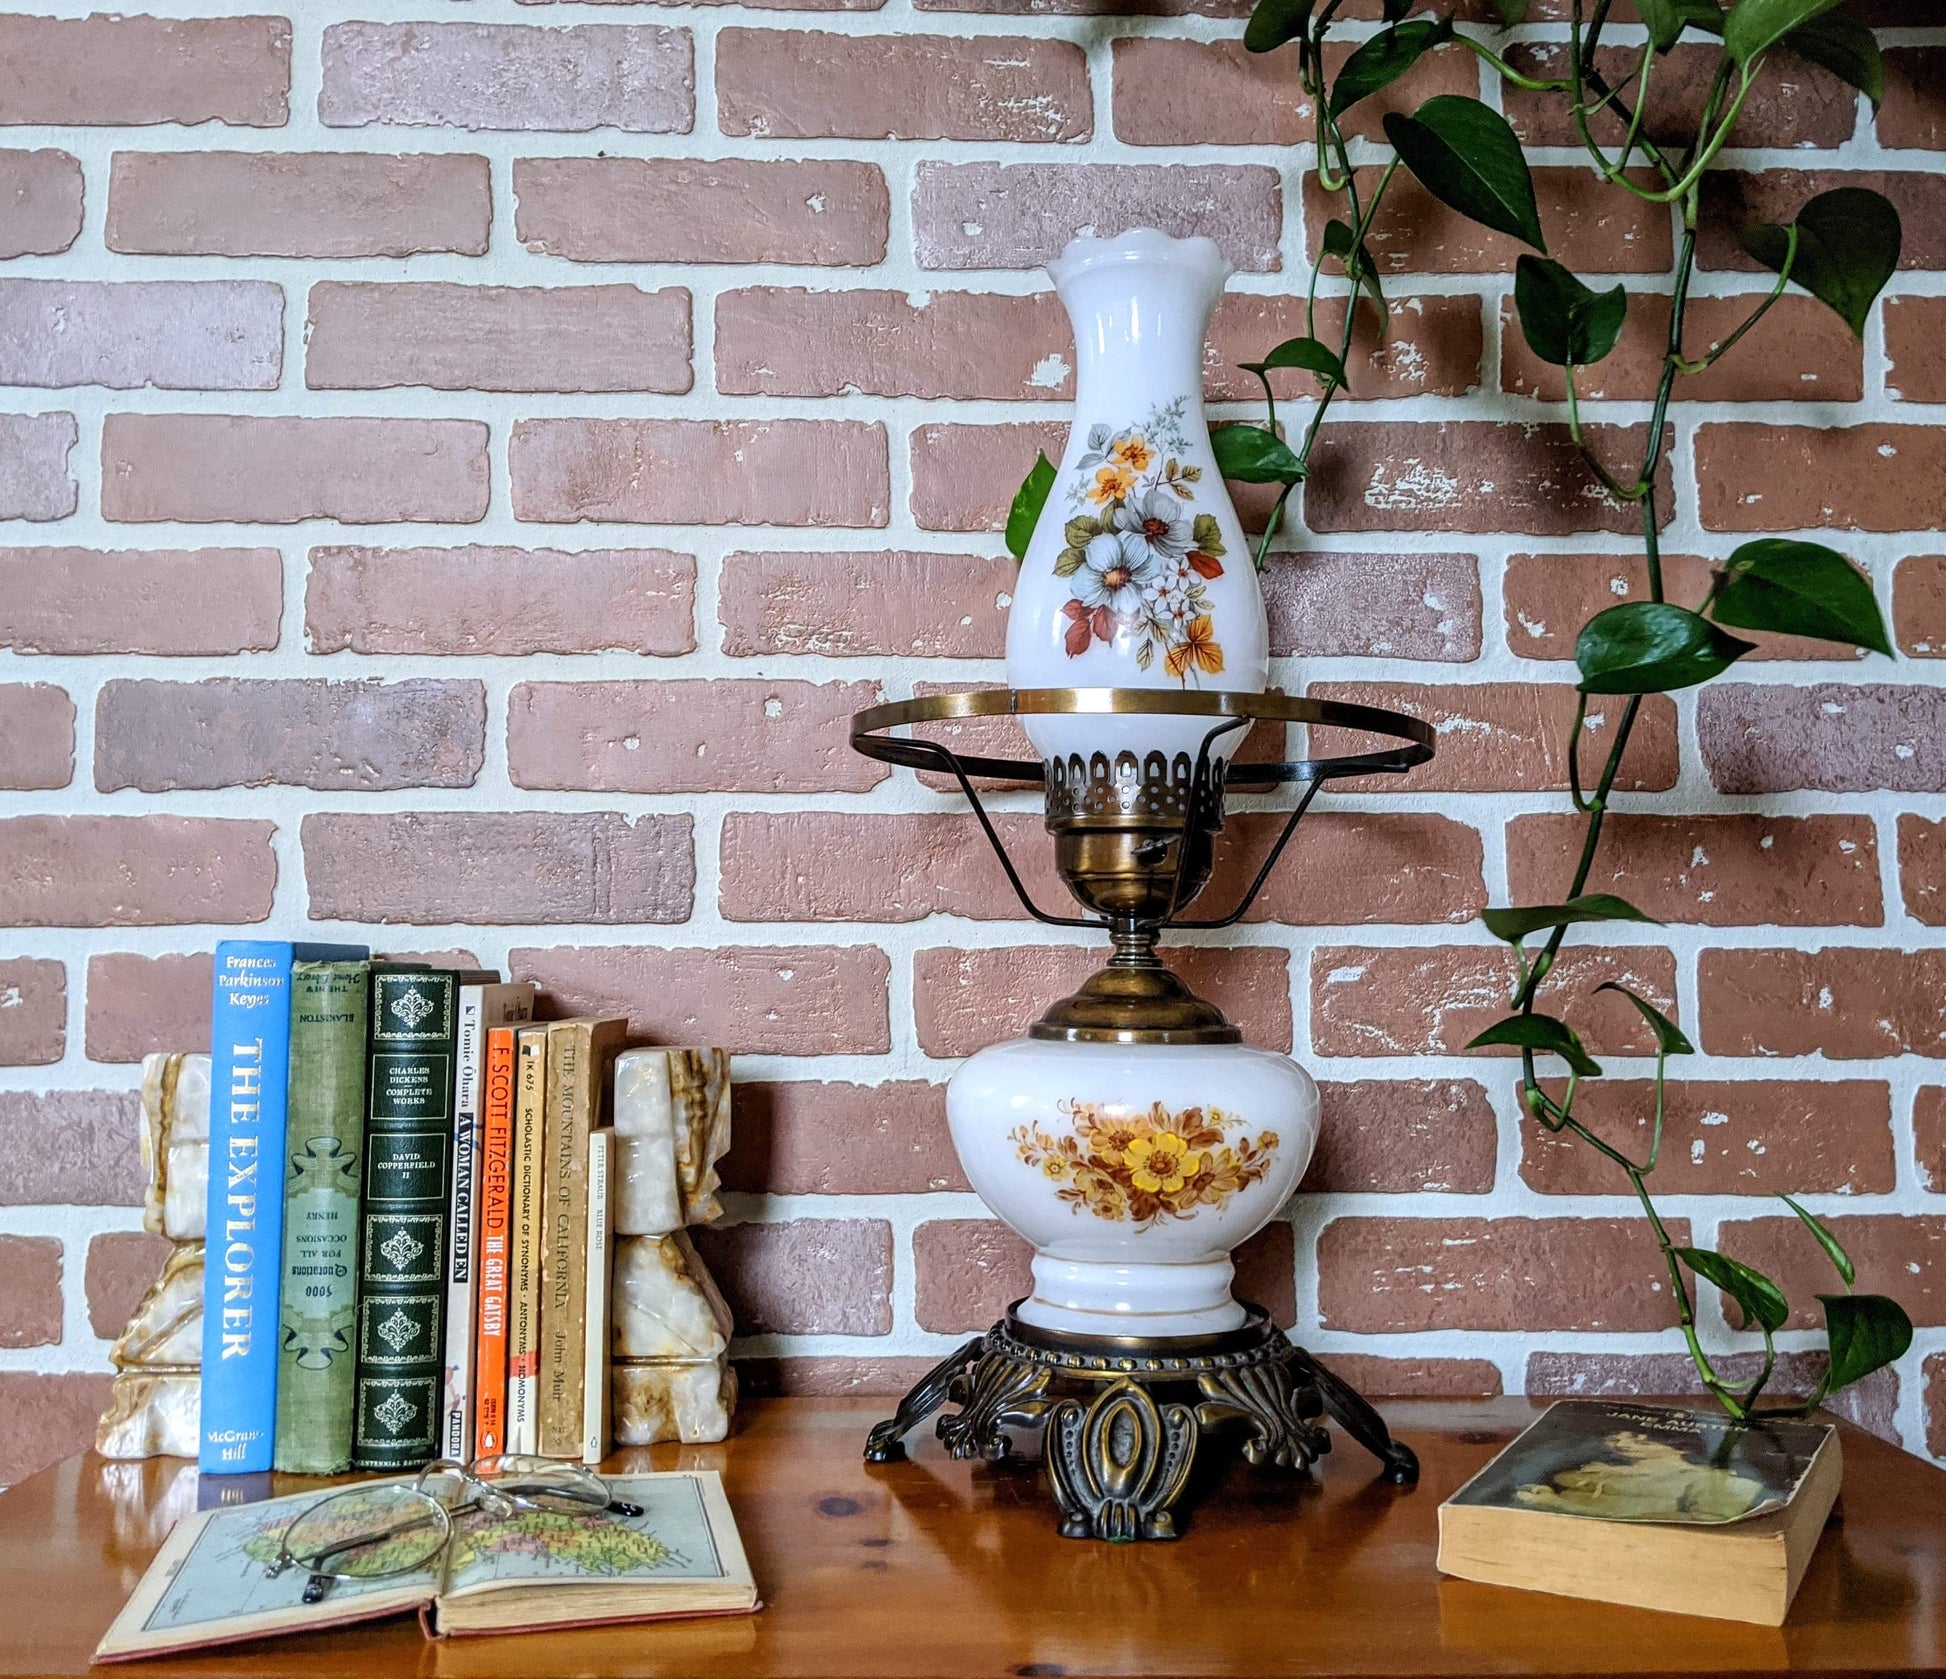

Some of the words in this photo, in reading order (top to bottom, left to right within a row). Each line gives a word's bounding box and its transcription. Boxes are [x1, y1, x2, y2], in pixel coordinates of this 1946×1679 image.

[226, 956, 276, 968] Frances
[219, 970, 284, 987] Parkinson
[333, 973, 360, 984] Home
[305, 985, 325, 993] NEW
[329, 985, 348, 993] THE
[229, 992, 269, 1008] Keyes
[300, 1013, 354, 1023] BLAKISTON
[463, 1019, 475, 1062] Tomie
[492, 1047, 509, 1059] F.
[563, 1044, 576, 1078] THE
[389, 1067, 430, 1075] CHARLES
[389, 1076, 429, 1084] DICKENS
[230, 1037, 263, 1124] THE
[526, 1073, 534, 1091] 675
[386, 1088, 433, 1096] COMPLETE
[490, 1064, 509, 1119] SCOTT
[393, 1097, 426, 1105] WORKS
[459, 1115, 471, 1127] A
[523, 1108, 533, 1162] SCHOLASTIC
[559, 1085, 574, 1179] MOUNTAINS
[377, 1161, 435, 1170] COPPERFIELD
[392, 1153, 420, 1161] DAVID
[458, 1130, 473, 1189] WOMAN
[402, 1171, 410, 1179] II
[487, 1127, 507, 1229] FITZGERALD
[521, 1165, 532, 1221] DICTIONARY
[596, 1170, 604, 1200] STRAUB
[558, 1186, 571, 1207] OF
[306, 1211, 338, 1220] HENRY
[455, 1192, 469, 1254] CALLED
[296, 1234, 347, 1243] OCCASIONS
[521, 1223, 530, 1236] OF
[222, 1135, 259, 1361] EXPLORER
[486, 1235, 504, 1254] THE
[595, 1230, 603, 1250] ROSE
[300, 1250, 318, 1258] ALL
[322, 1250, 341, 1258] FOR
[555, 1214, 570, 1309] CALIFORNIA
[292, 1264, 348, 1277] Quotations
[454, 1258, 467, 1279] EN
[485, 1258, 503, 1291] GREAT
[520, 1239, 529, 1292] SYNONYMS
[305, 1285, 333, 1298] 5000
[484, 1296, 502, 1336] GATSBY
[518, 1301, 528, 1355] ANTONYMS
[554, 1332, 566, 1363] John
[516, 1365, 526, 1423] HOMONYMS
[553, 1370, 565, 1402] Muir
[1606, 1411, 1659, 1423] JANE
[450, 1411, 461, 1457] PANDORA
[1640, 1421, 1701, 1433] EMMA
[221, 1442, 247, 1461] Hill
